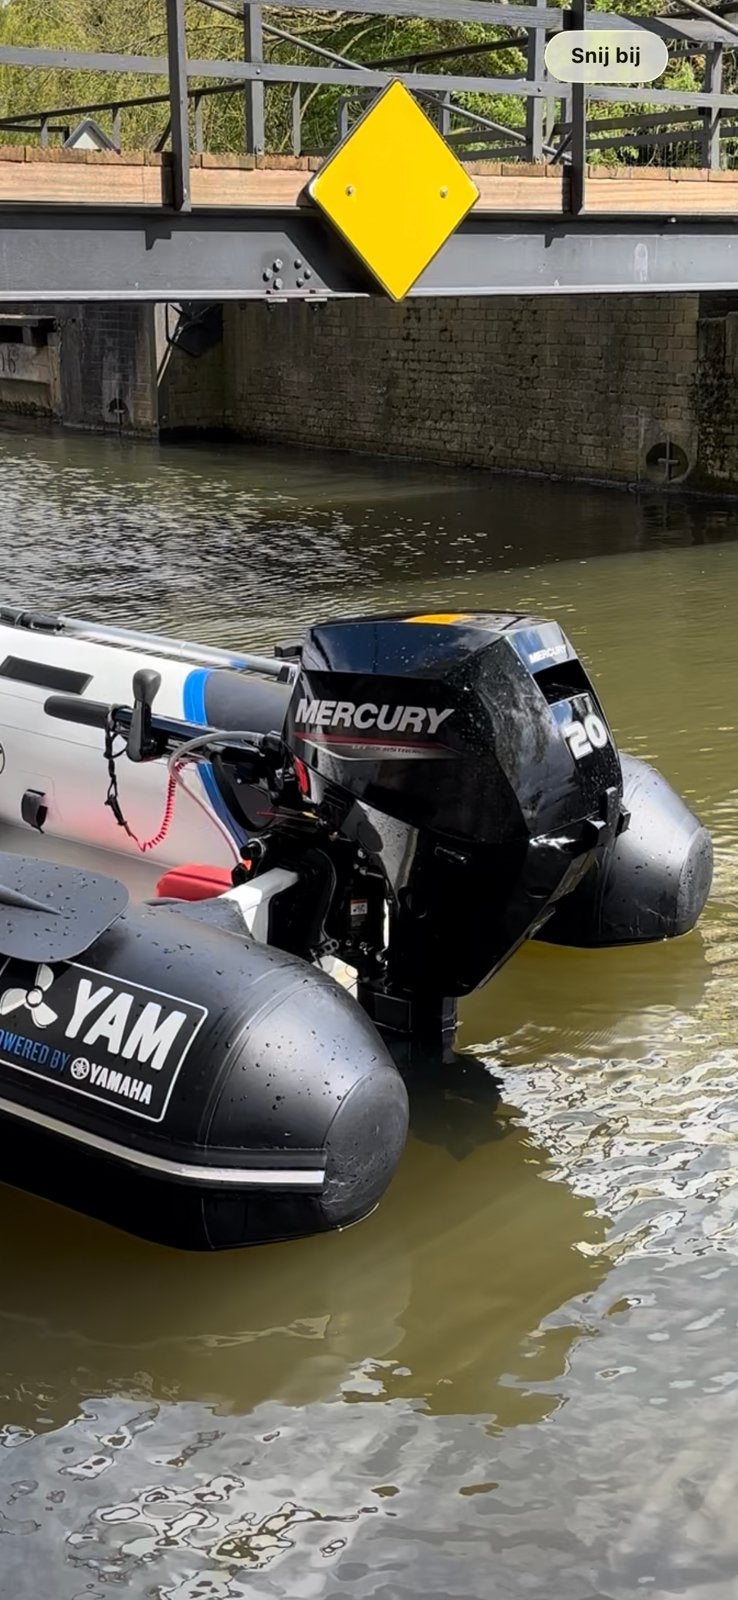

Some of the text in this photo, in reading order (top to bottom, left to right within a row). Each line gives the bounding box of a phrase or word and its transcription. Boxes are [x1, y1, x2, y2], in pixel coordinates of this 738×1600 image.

[294, 698, 455, 734] MERCURY
[564, 714, 608, 760] 20
[64, 978, 188, 1071] YAM
[50, 1049, 71, 1072] BY
[88, 1063, 153, 1105] YAMAHA
